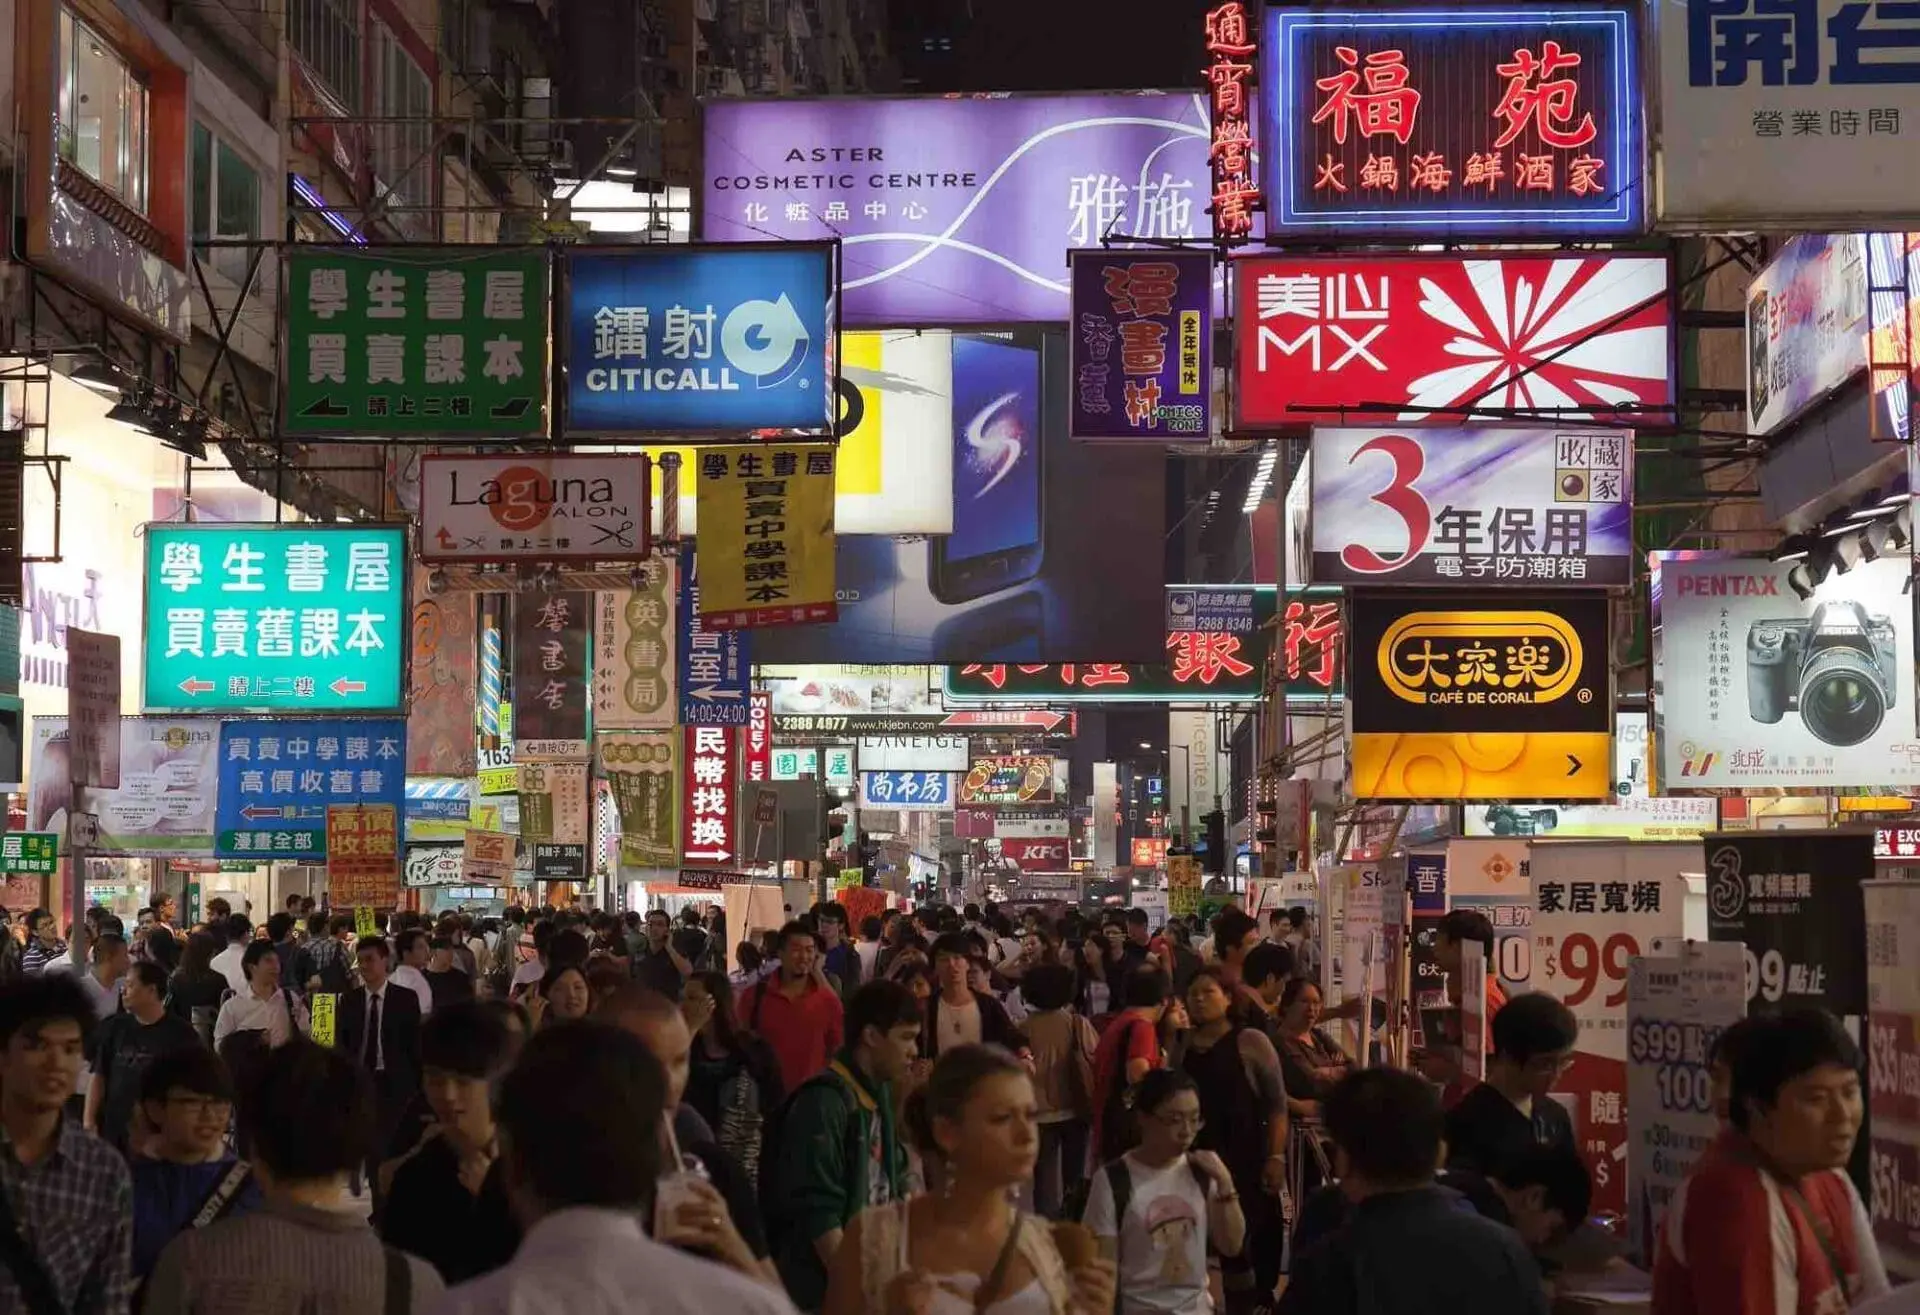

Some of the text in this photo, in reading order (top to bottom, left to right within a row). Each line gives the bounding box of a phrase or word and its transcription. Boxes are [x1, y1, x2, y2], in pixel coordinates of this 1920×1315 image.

[1312, 41, 1597, 149] 福苑
[1205, 2, 1260, 232] 通宵營業
[1753, 108, 1900, 137] 營業時間
[785, 147, 885, 162] ASTER
[713, 172, 977, 190] COSMETIC CENTRE
[1314, 152, 1606, 193] 火鍋海鮮酒家
[744, 201, 928, 222] 化粧品中心
[1066, 173, 1194, 249] 雅施
[308, 269, 525, 320] 學生書屋
[1257, 273, 1389, 320] 美心
[594, 304, 717, 360] 鐳射
[308, 334, 524, 384] 買賣課本
[1183, 316, 1198, 385] 全年無休
[1257, 324, 1389, 372] MX
[586, 368, 739, 391] CITICALL
[367, 397, 471, 416] 請上二樓
[1151, 406, 1203, 418] COMICS
[1168, 419, 1203, 431] ZONE
[702, 452, 834, 479] 學生書屋
[450, 470, 614, 522] Laguna
[538, 506, 628, 518] SALON
[500, 537, 570, 551] 請上二樓
[160, 541, 391, 592] 學生書屋
[1434, 555, 1587, 579] 電子防潮箱
[1677, 574, 1781, 597] PENTAX
[164, 608, 386, 659] 買賣舊課本
[1197, 617, 1223, 630] 2988
[227, 676, 315, 698] 請上二樓
[1430, 688, 1533, 704] CAFÉ DE CORAL
[684, 704, 746, 723] 14:00-24:00
[749, 697, 767, 752] MONEY
[228, 736, 399, 761] 買賣中學課本
[240, 769, 385, 794] 高價收舊書
[692, 727, 728, 846] 民幣找換
[233, 832, 313, 851] 漫畫全部
[1022, 846, 1063, 859] KFC
[682, 870, 713, 883] MONEY
[1538, 880, 1661, 914] 家居寬頻
[1418, 962, 1448, 977] 6大
[1590, 1091, 1627, 1124] 隨
